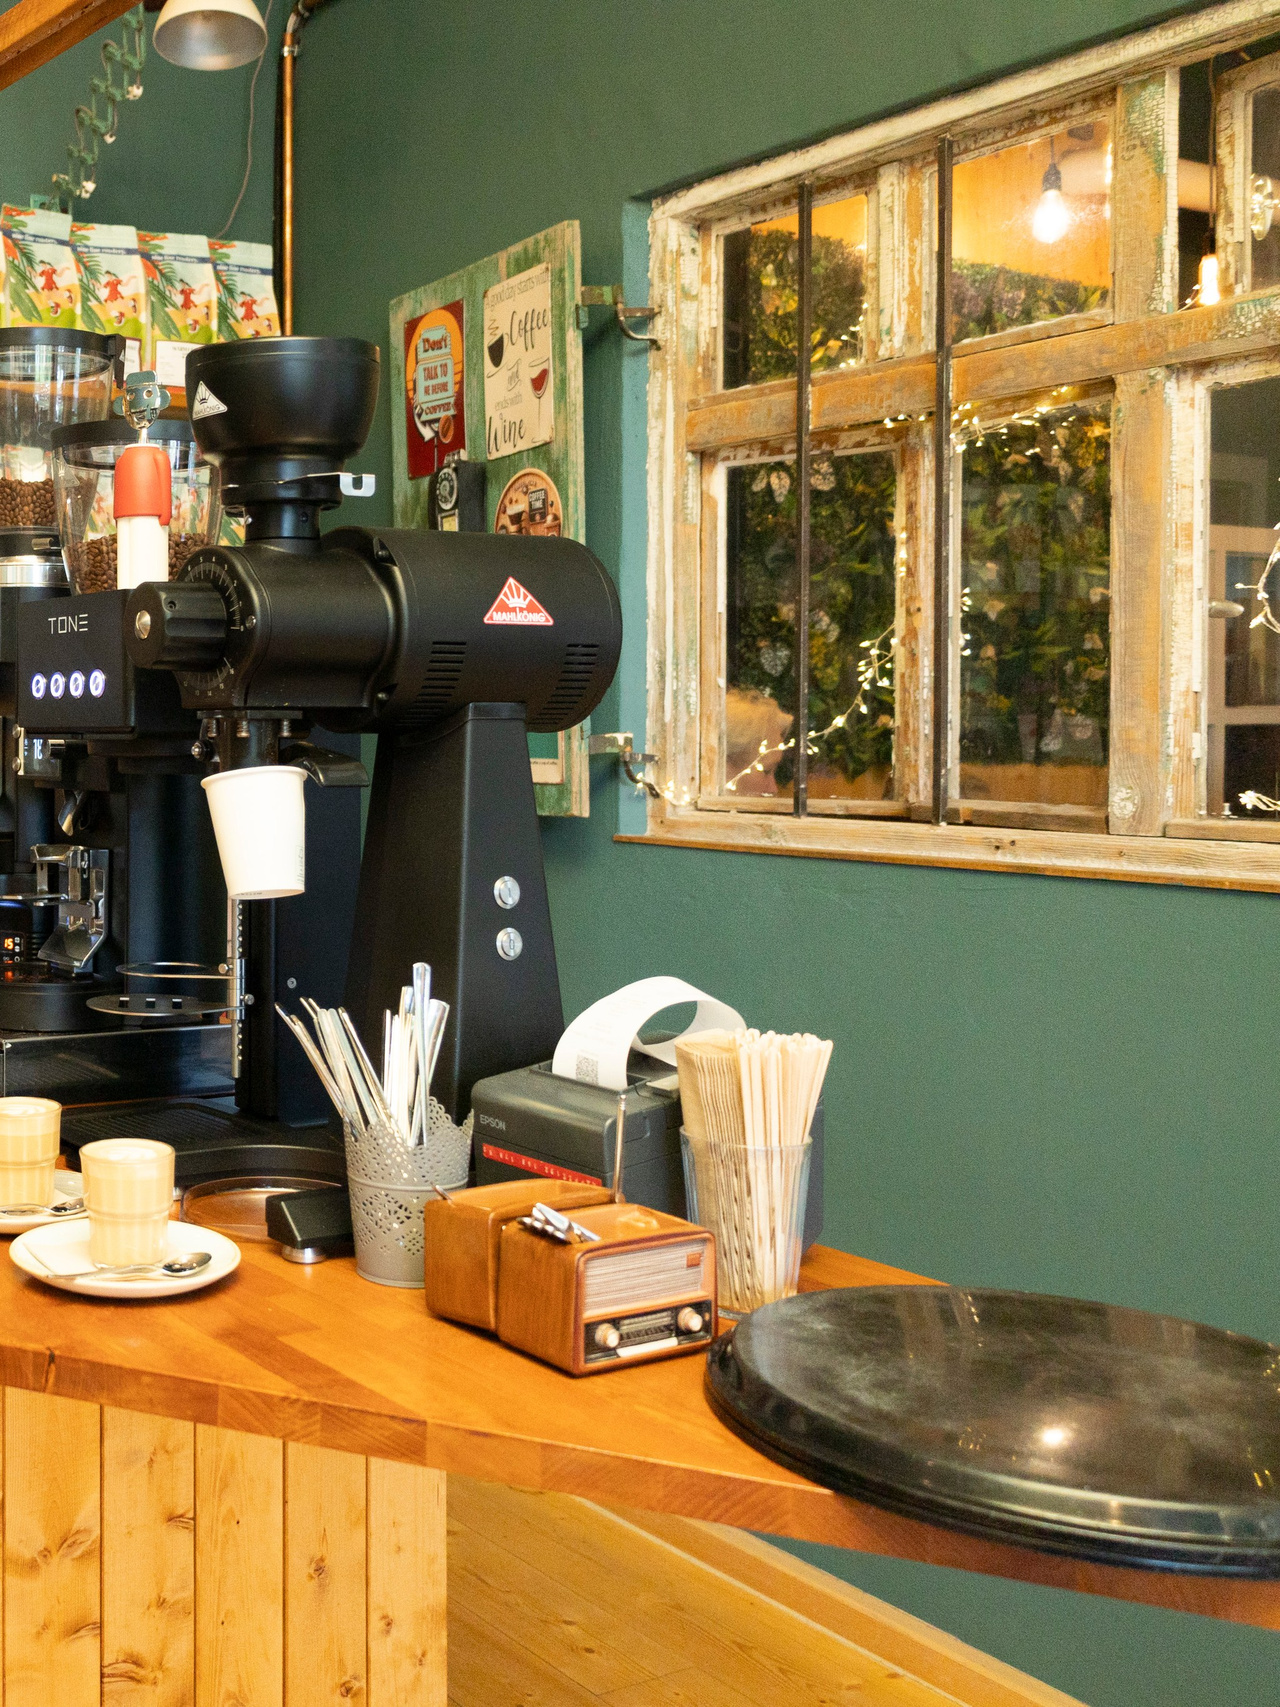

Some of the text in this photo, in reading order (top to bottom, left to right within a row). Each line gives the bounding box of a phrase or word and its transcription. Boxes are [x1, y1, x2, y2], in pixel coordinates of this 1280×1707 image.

[510, 308, 548, 352] Coffee
[422, 334, 448, 353] Don't
[423, 362, 448, 381] TALK TO
[423, 381, 449, 396] ME BEFORE
[424, 402, 452, 415] COFFEE
[486, 413, 524, 454] Wine
[529, 490, 545, 501] COFFEE
[532, 499, 543, 509] TIME
[492, 608, 546, 622] MAHLKÖNIG
[48, 613, 89, 635] TONE
[4, 937, 14, 950] 15
[480, 1114, 506, 1131] EPSON
